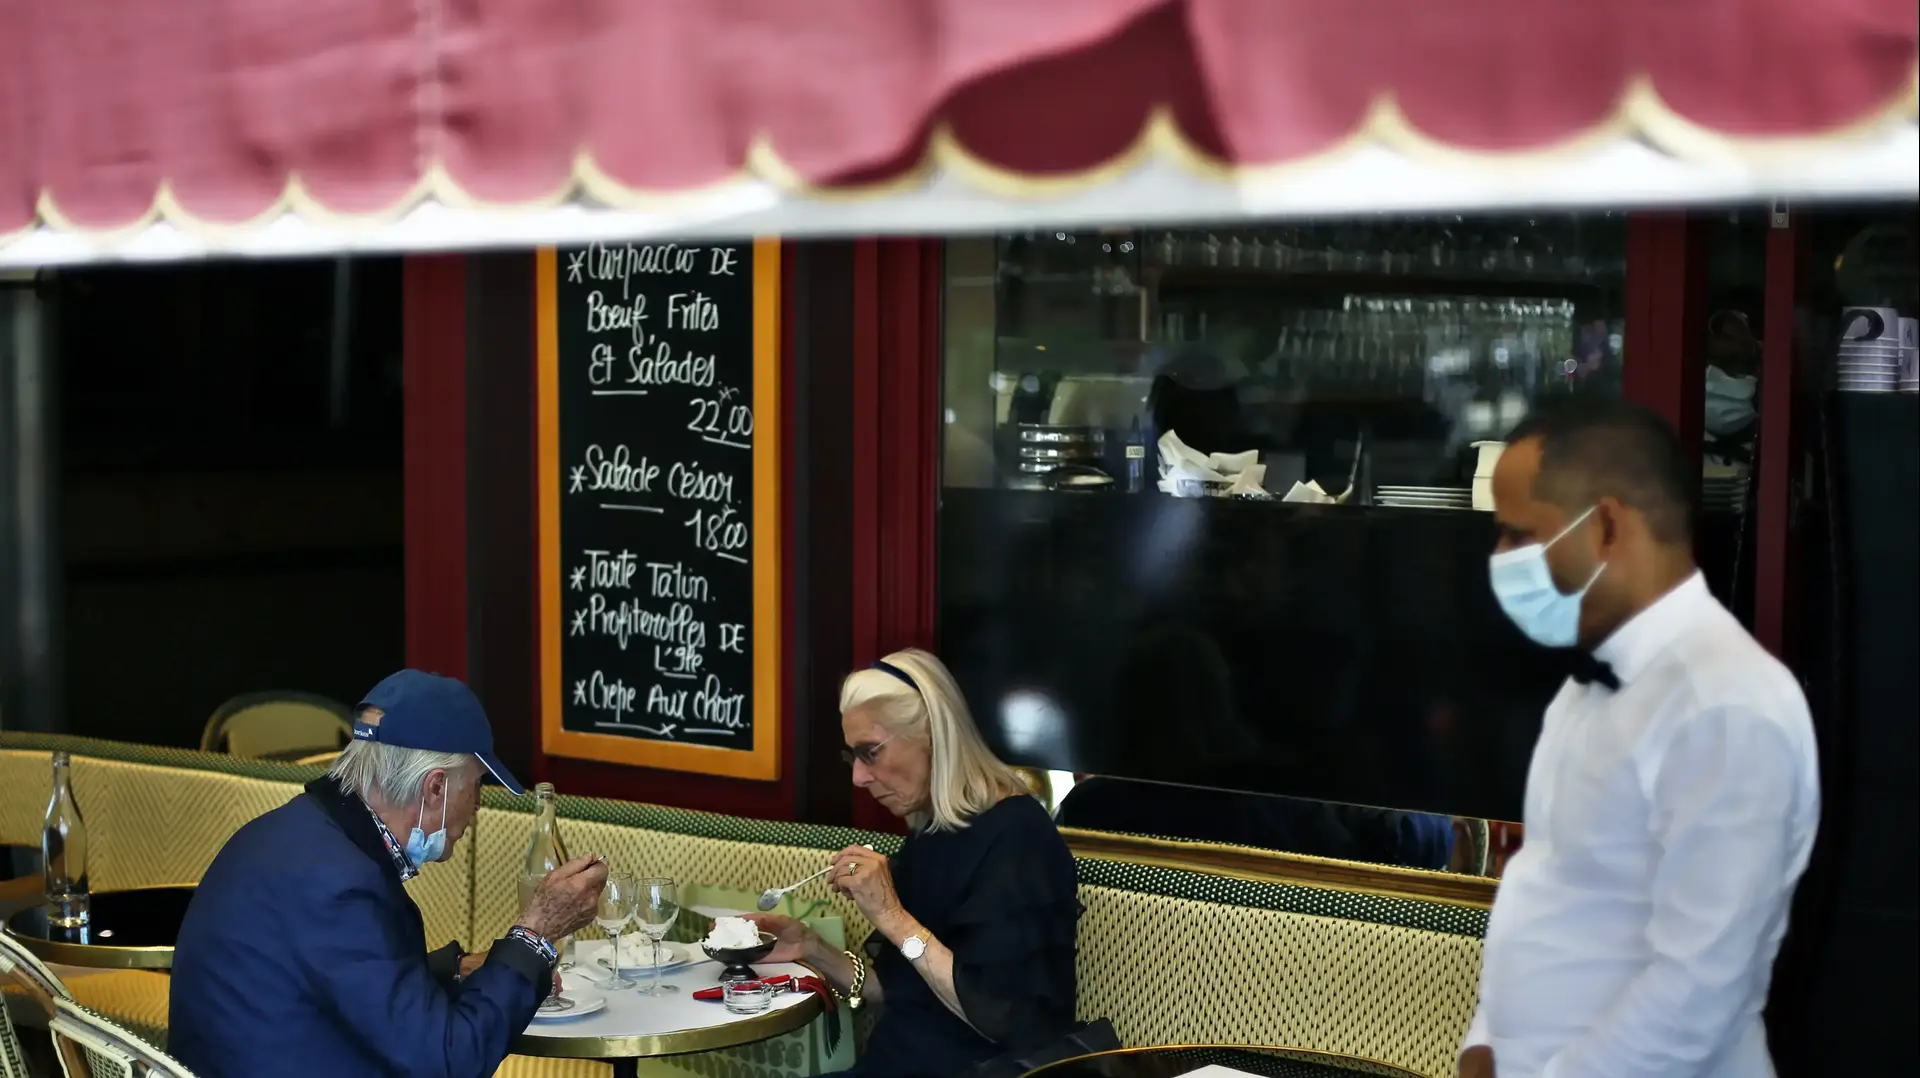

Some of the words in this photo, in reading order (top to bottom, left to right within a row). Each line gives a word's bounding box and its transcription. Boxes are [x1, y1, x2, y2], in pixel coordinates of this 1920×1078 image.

[709, 247, 738, 276] DE
[667, 290, 719, 331] Frites
[588, 343, 616, 384] Et
[687, 398, 754, 442] 22,00
[586, 444, 660, 492] Salade
[584, 549, 638, 589] Tarte
[590, 593, 706, 650] Profiterolles
[718, 622, 746, 653] DE
[646, 684, 688, 720] Aux
